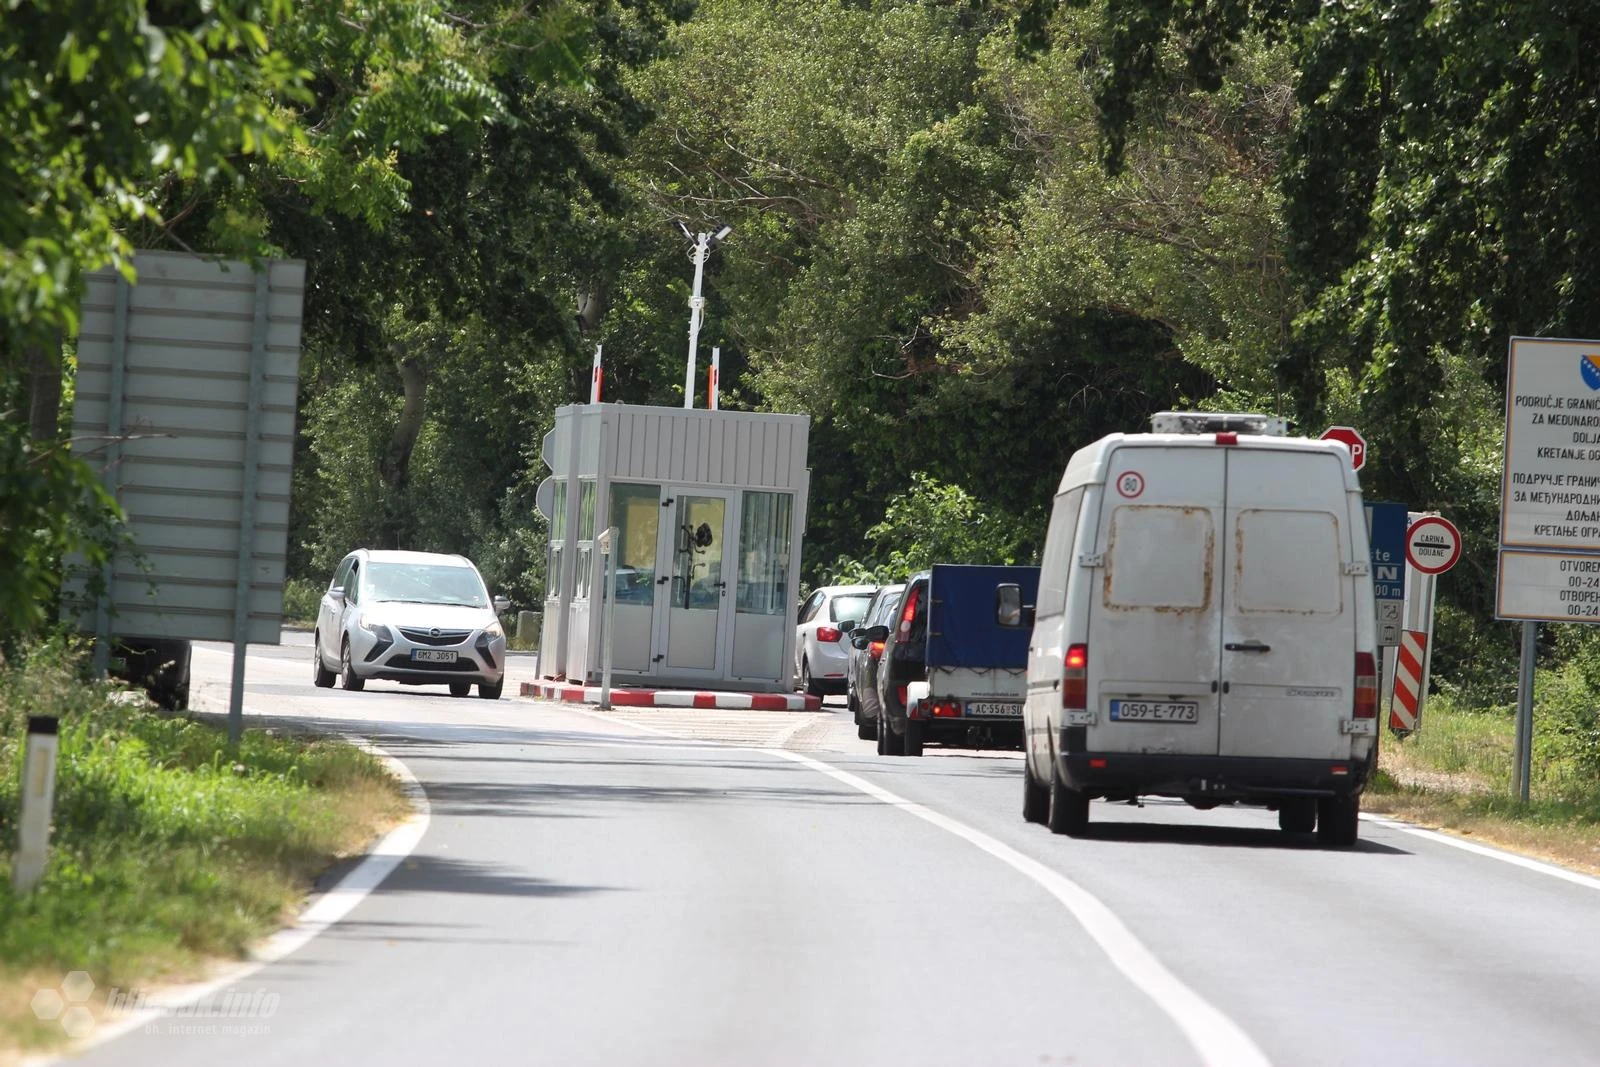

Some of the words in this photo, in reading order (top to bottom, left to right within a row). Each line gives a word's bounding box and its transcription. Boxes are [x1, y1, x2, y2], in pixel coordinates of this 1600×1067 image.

[1515, 394, 1564, 408] PODRUČJE
[1531, 413, 1544, 424] ZA
[1537, 447, 1586, 460] KRETANJE
[1513, 472, 1564, 486] ПОДРУЧЈЕ
[1514, 490, 1527, 502] ЗА
[1534, 524, 1580, 537] КРЕТАЊЕ
[1420, 534, 1445, 544] CARINA
[1418, 547, 1445, 557] DOUANE
[1569, 576, 1599, 588] 00-24
[1567, 604, 1599, 616] 00-24
[1121, 703, 1195, 720] 059-E-773
